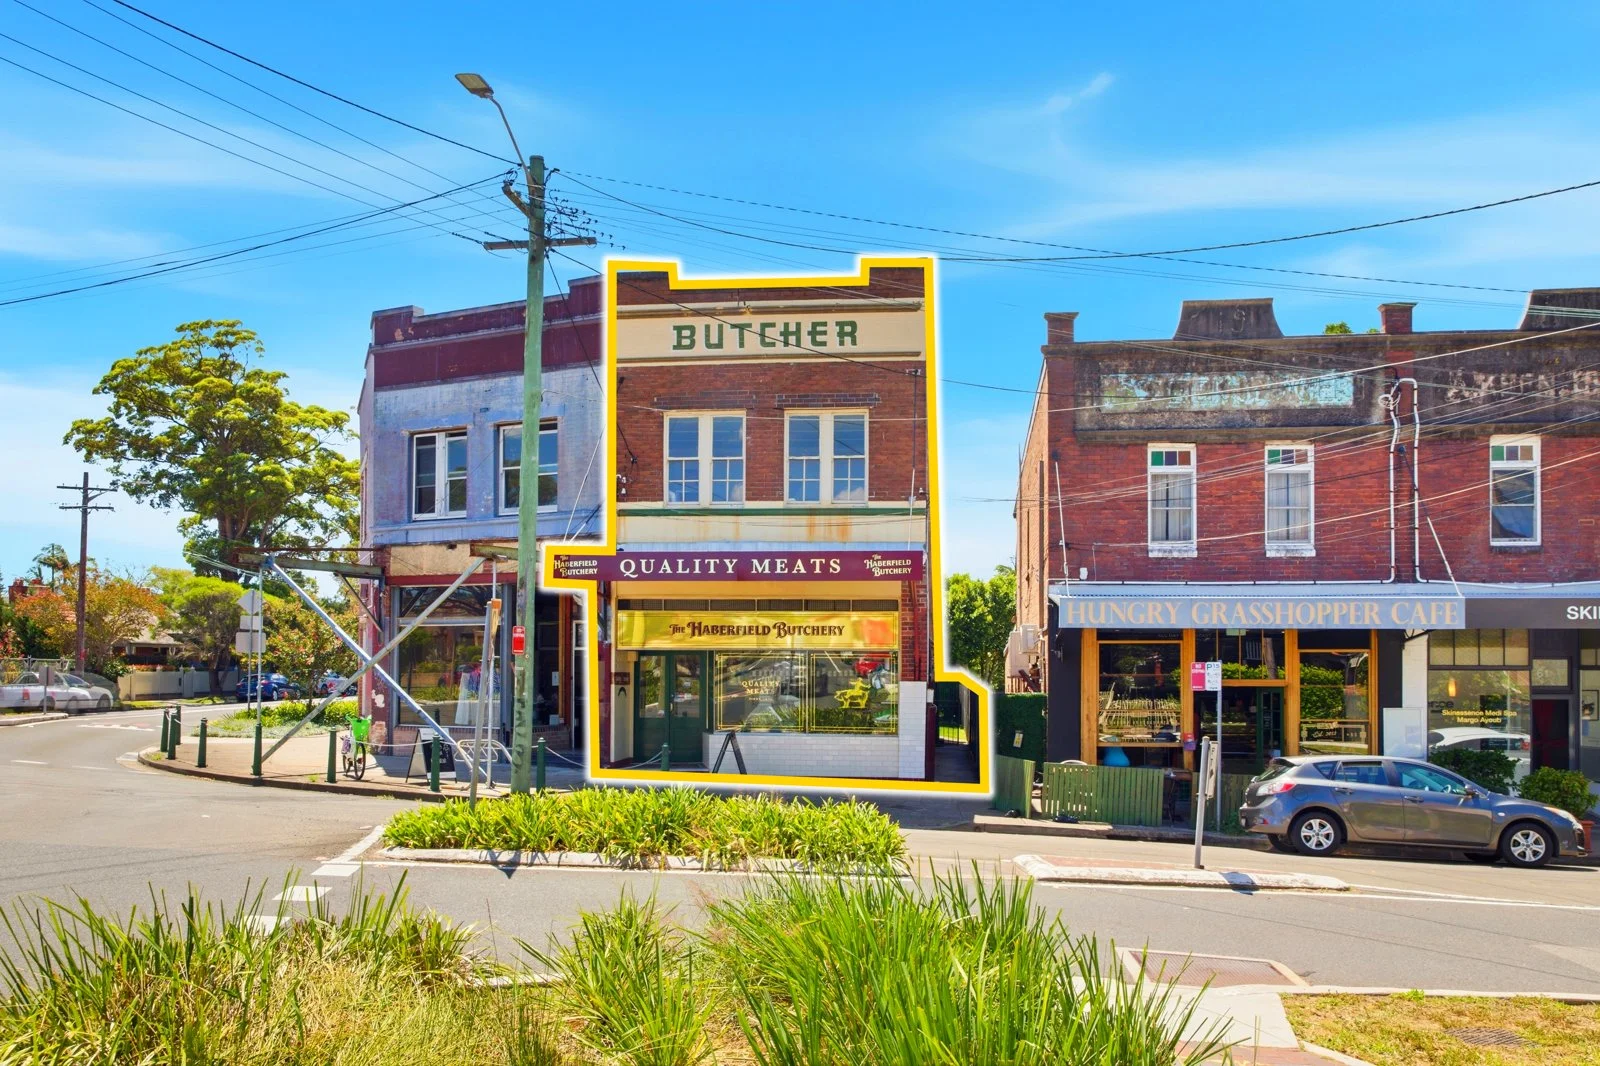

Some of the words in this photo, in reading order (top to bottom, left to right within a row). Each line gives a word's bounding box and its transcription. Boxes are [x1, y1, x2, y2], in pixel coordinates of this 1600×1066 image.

[672, 320, 858, 350] BUTCHER
[619, 558, 739, 577] QUALITY
[751, 558, 841, 574] MEATS
[864, 559, 912, 569] HABERFIELD
[872, 567, 912, 577] BUTCHERY
[560, 568, 598, 577] BUTCHERY
[1066, 601, 1182, 625] HUNGRY
[1190, 601, 1382, 625] GRASSHOPPER
[1391, 601, 1459, 625] CAFE
[1566, 605, 1600, 620] SKI
[669, 623, 686, 635] THE
[687, 621, 771, 638] HABERFIELD
[772, 621, 845, 638] BUTCHERY
